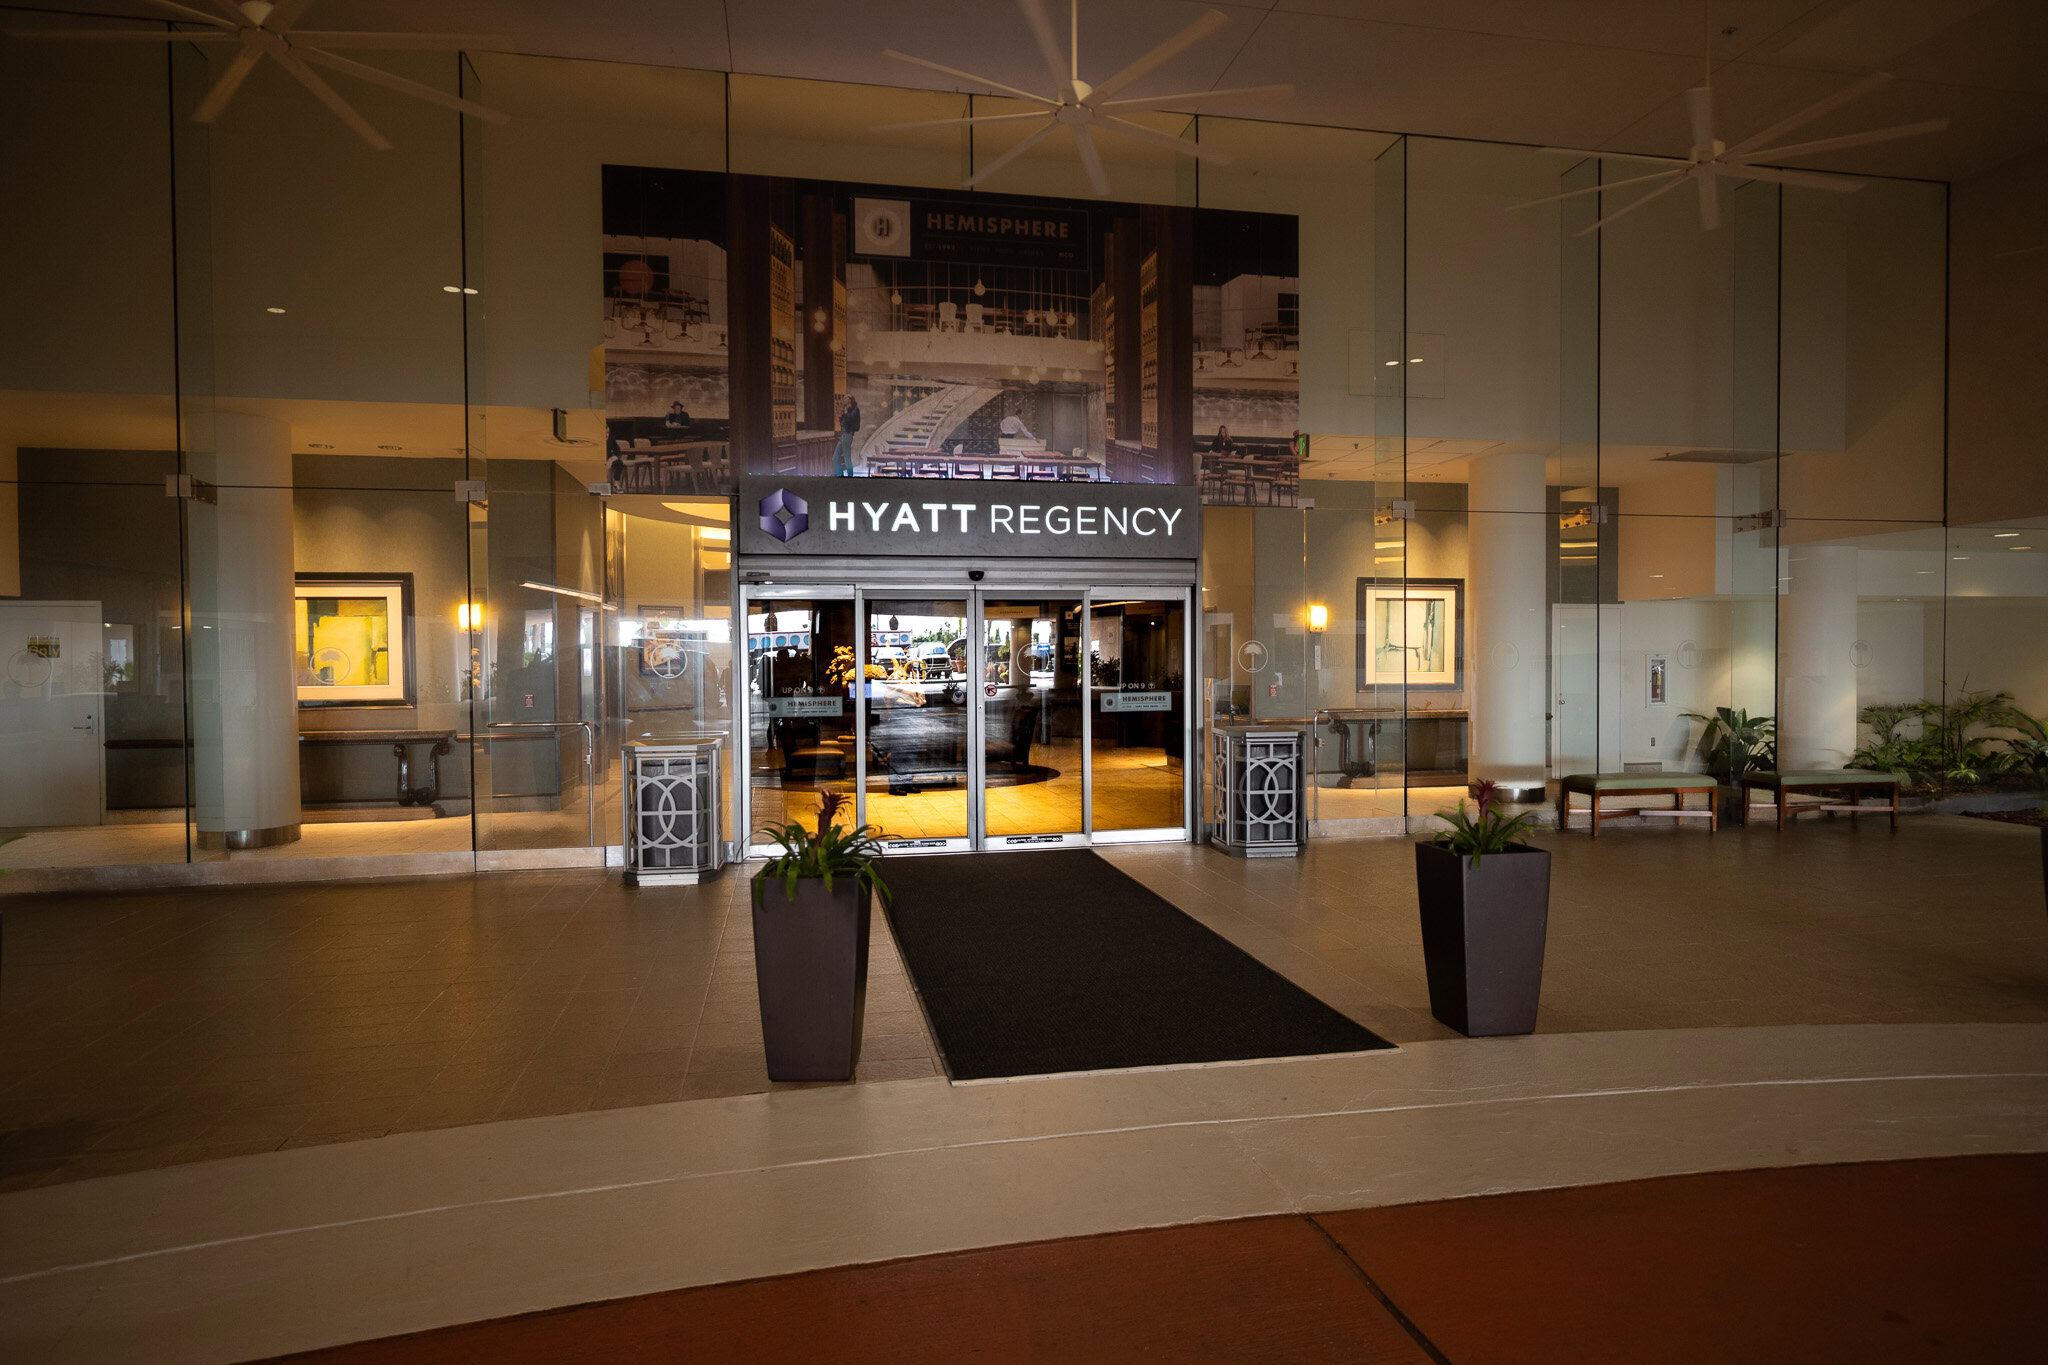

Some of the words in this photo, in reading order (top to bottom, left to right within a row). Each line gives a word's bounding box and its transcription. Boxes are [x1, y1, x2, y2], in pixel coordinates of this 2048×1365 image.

[926, 212, 1071, 239] HEMISPHERE
[828, 501, 977, 533] HYATT
[989, 504, 1183, 537] REGENCY
[782, 686, 793, 694] UP
[1127, 682, 1140, 690] ON
[1140, 682, 1146, 690] 9
